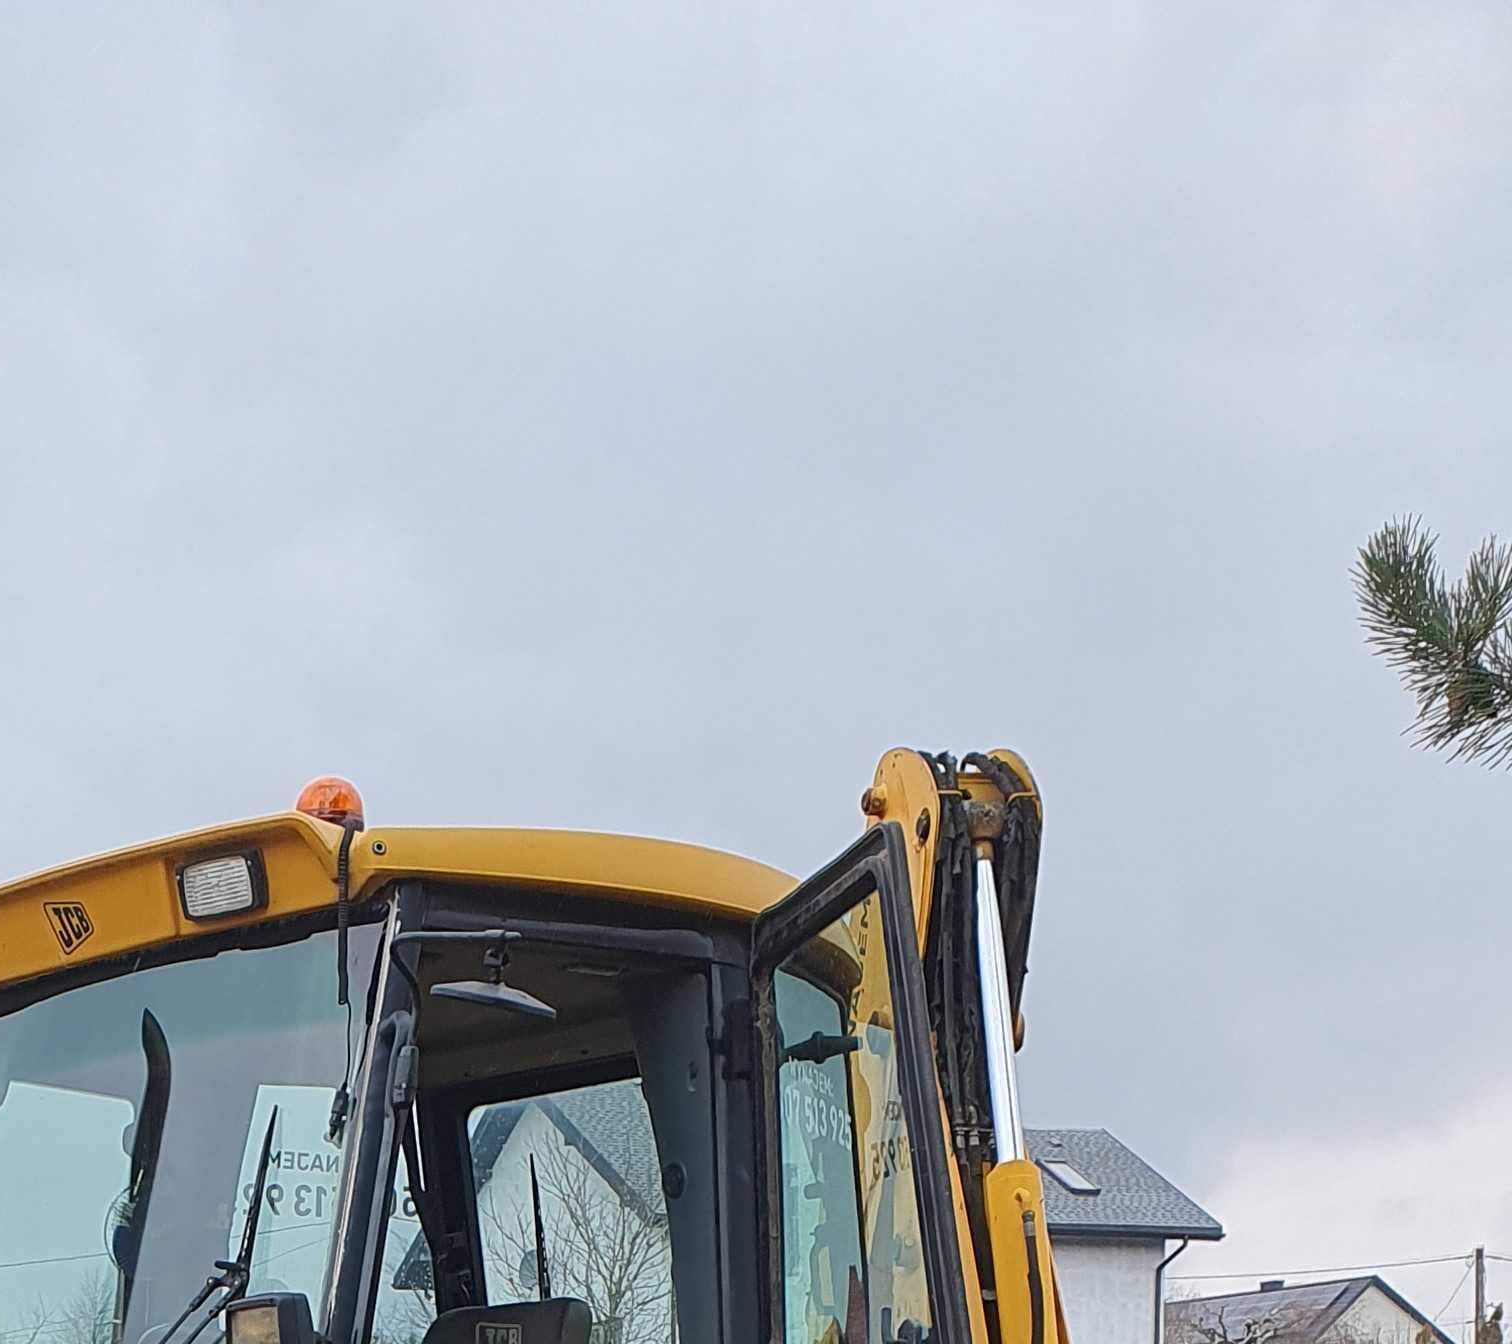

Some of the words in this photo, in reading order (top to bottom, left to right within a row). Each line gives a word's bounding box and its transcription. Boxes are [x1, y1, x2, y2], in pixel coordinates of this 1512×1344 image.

[52, 906, 90, 948] JCB
[804, 1096, 828, 1137] 513
[829, 1105, 852, 1153] 925
